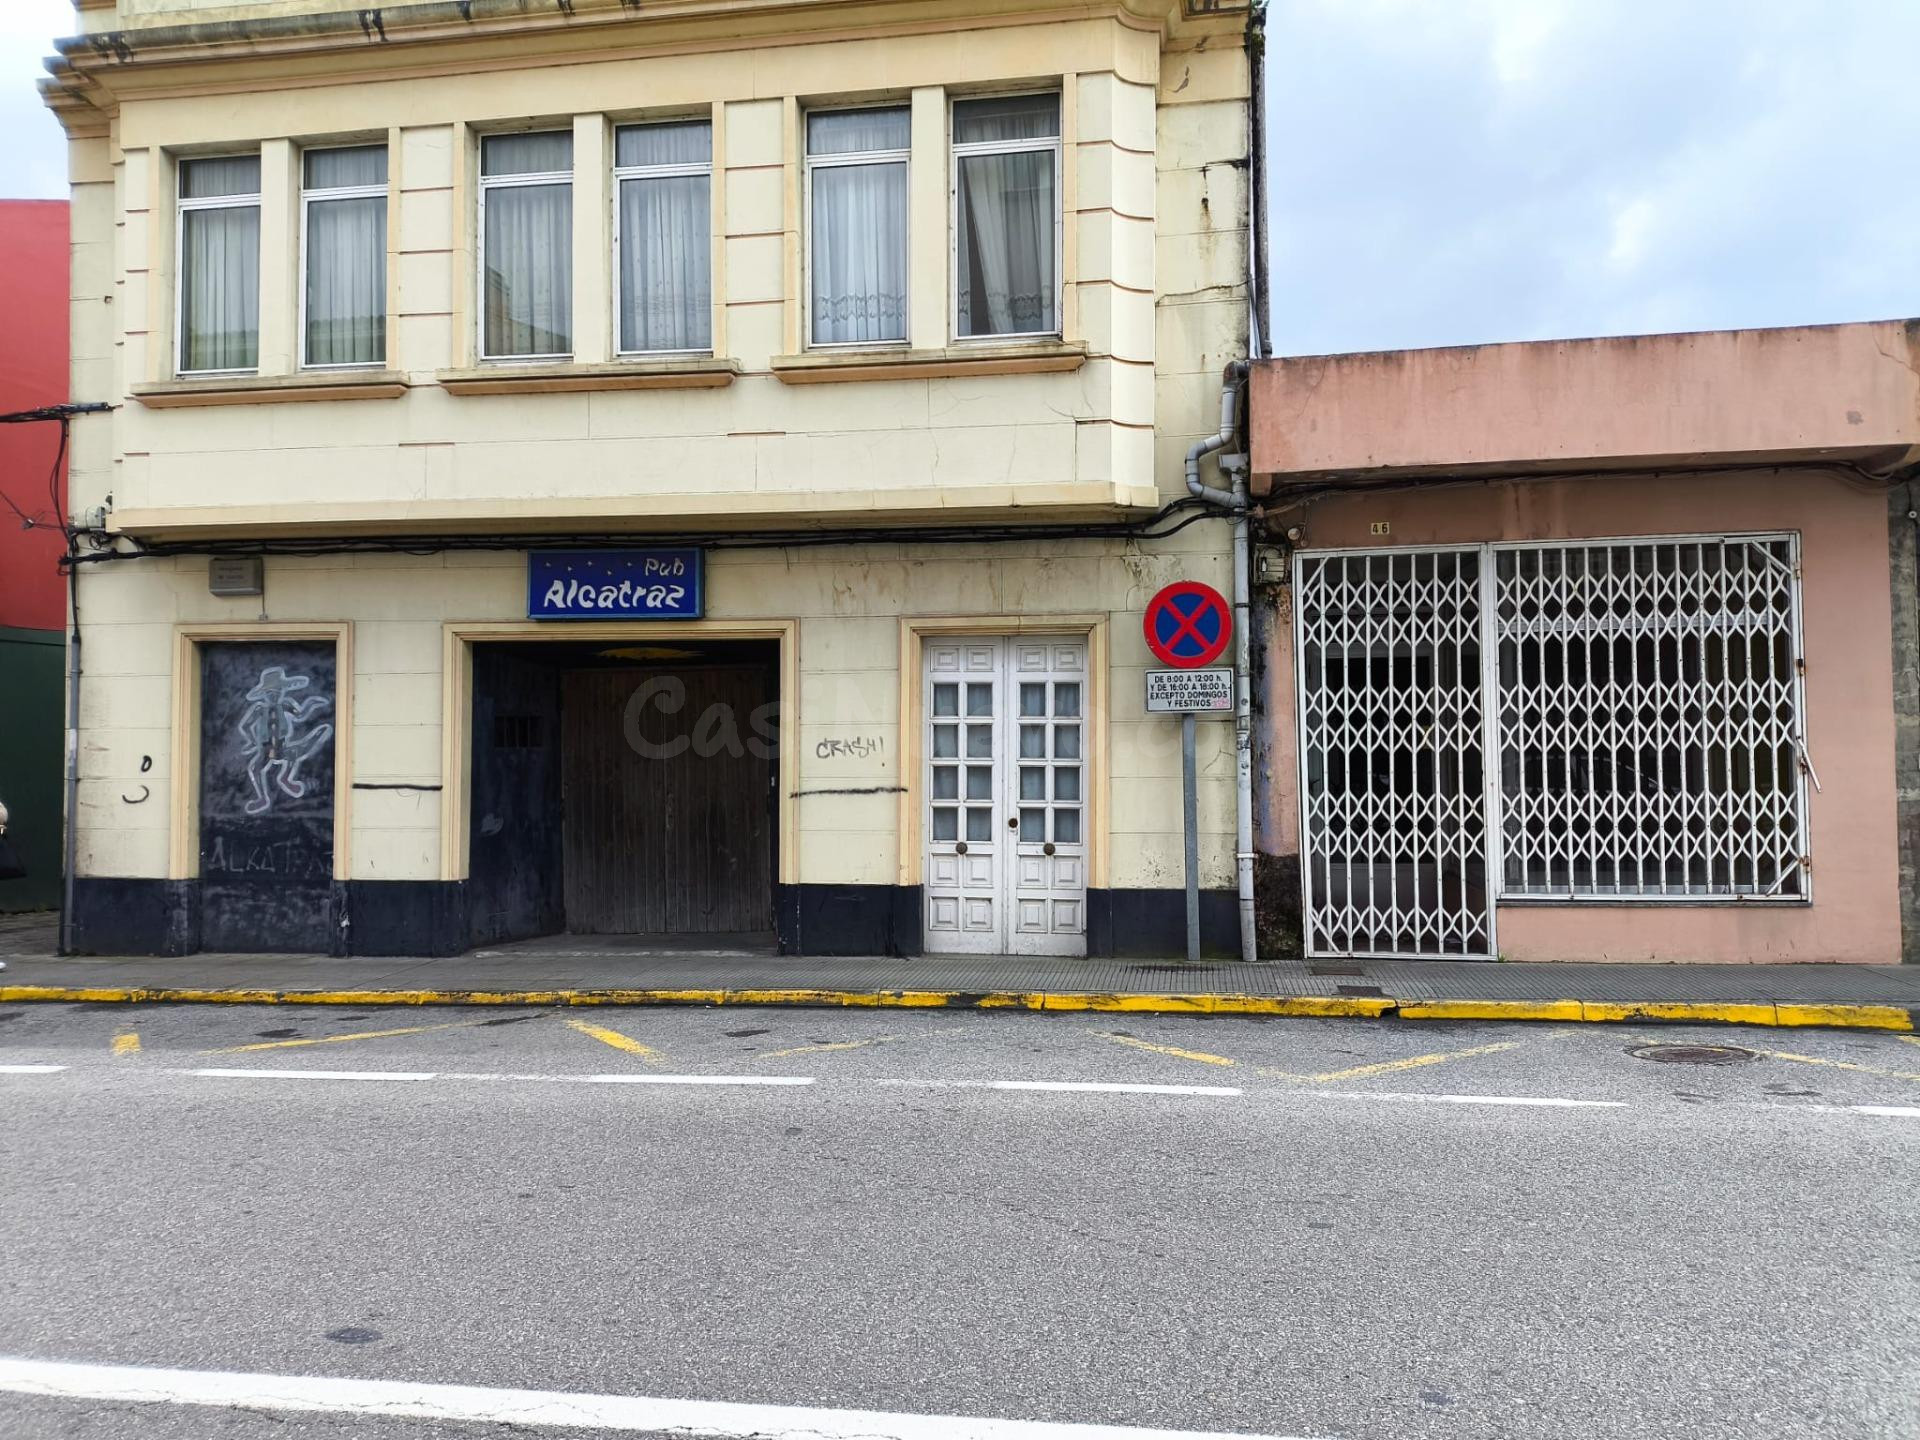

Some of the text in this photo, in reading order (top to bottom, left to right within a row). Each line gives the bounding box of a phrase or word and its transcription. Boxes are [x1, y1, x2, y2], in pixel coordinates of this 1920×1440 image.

[544, 579, 685, 608] Alcatraz
[1155, 675, 1165, 683] DE
[1167, 675, 1184, 683] 8:00
[1187, 674, 1192, 682] A
[1195, 674, 1214, 682] 12:00
[1150, 684, 1155, 692] Y
[1157, 683, 1167, 691] DE
[1192, 683, 1197, 691] A
[1150, 690, 1228, 700] EXCEPTO DOMINGOS
[1167, 700, 1172, 708] Y
[1174, 699, 1211, 708] FESTIVOS
